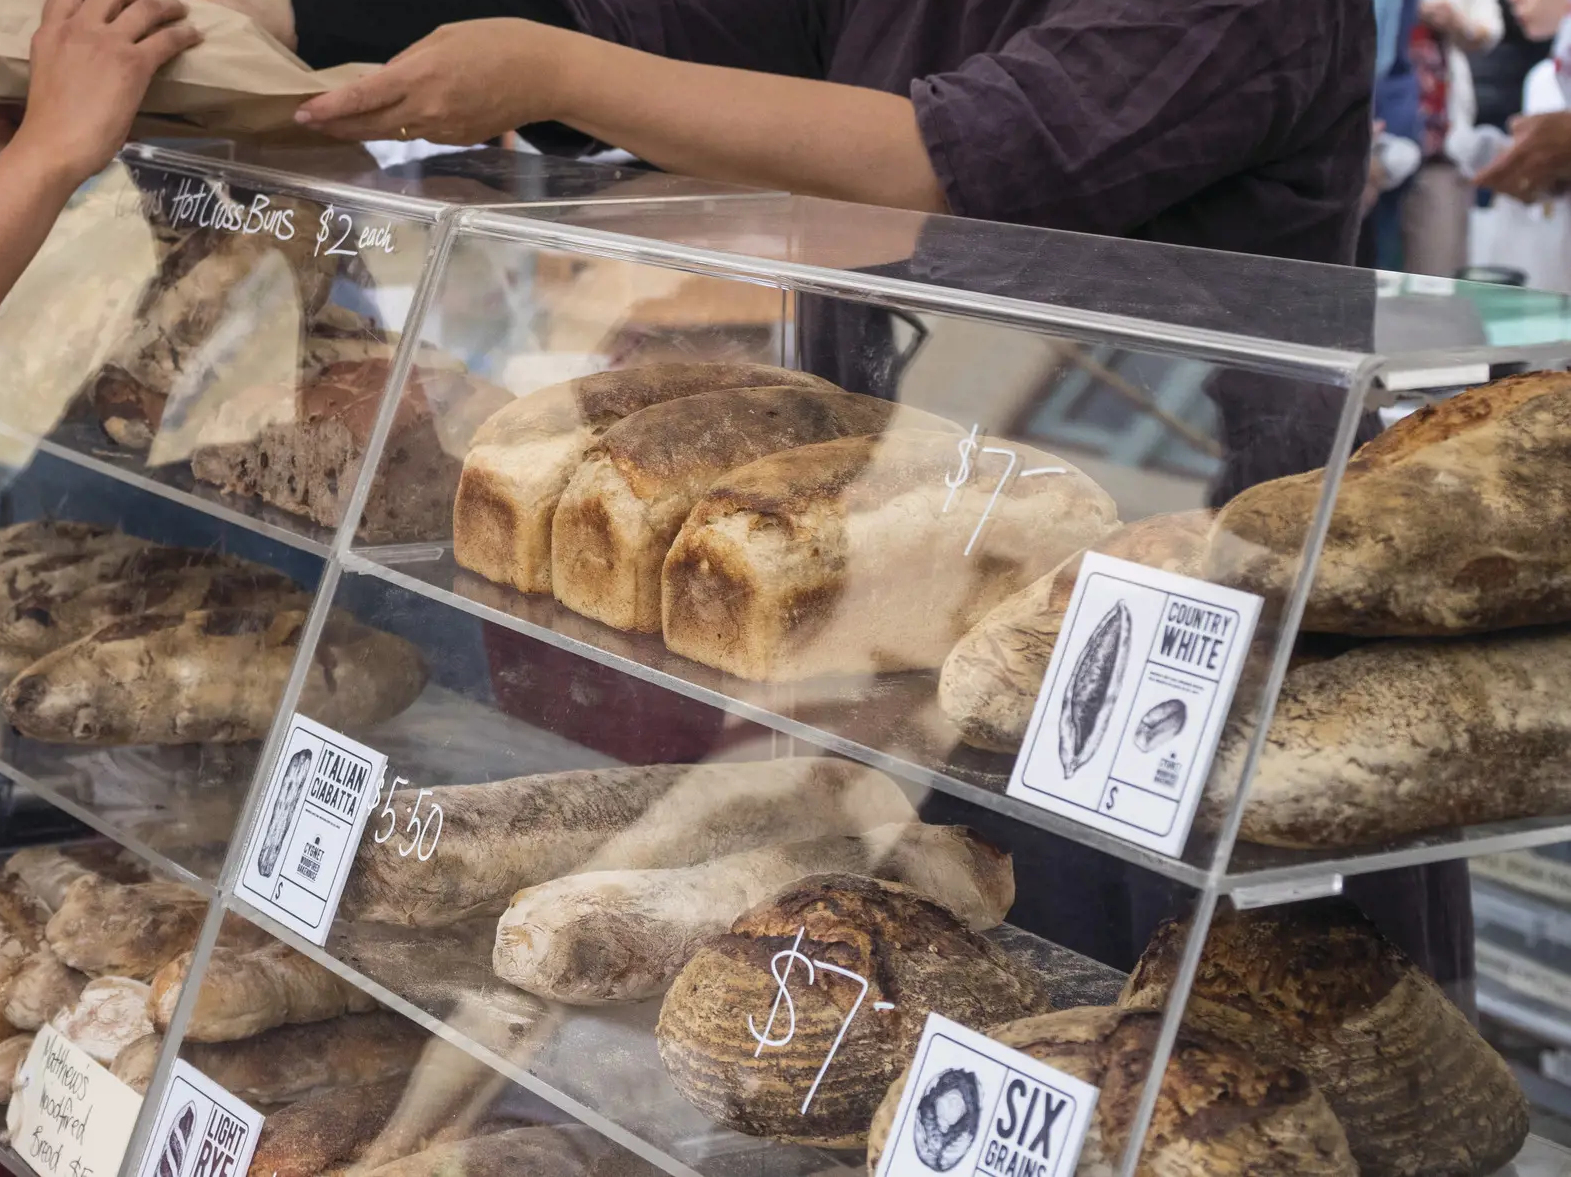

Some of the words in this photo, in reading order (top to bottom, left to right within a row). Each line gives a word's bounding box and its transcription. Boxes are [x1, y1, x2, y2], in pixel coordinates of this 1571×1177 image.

[242, 193, 295, 240] Buns
[313, 202, 359, 257] $2
[358, 221, 395, 253] each
[1168, 602, 1232, 637] COUNTRY
[1160, 625, 1223, 670] WHITE
[317, 748, 368, 794] ITALIAN
[310, 777, 358, 818] CIABATTA
[303, 842, 325, 862] CYGNET
[207, 1109, 246, 1156] LIGHT
[996, 1078, 1067, 1160] SIX
[30, 1125, 64, 1174] Bread
